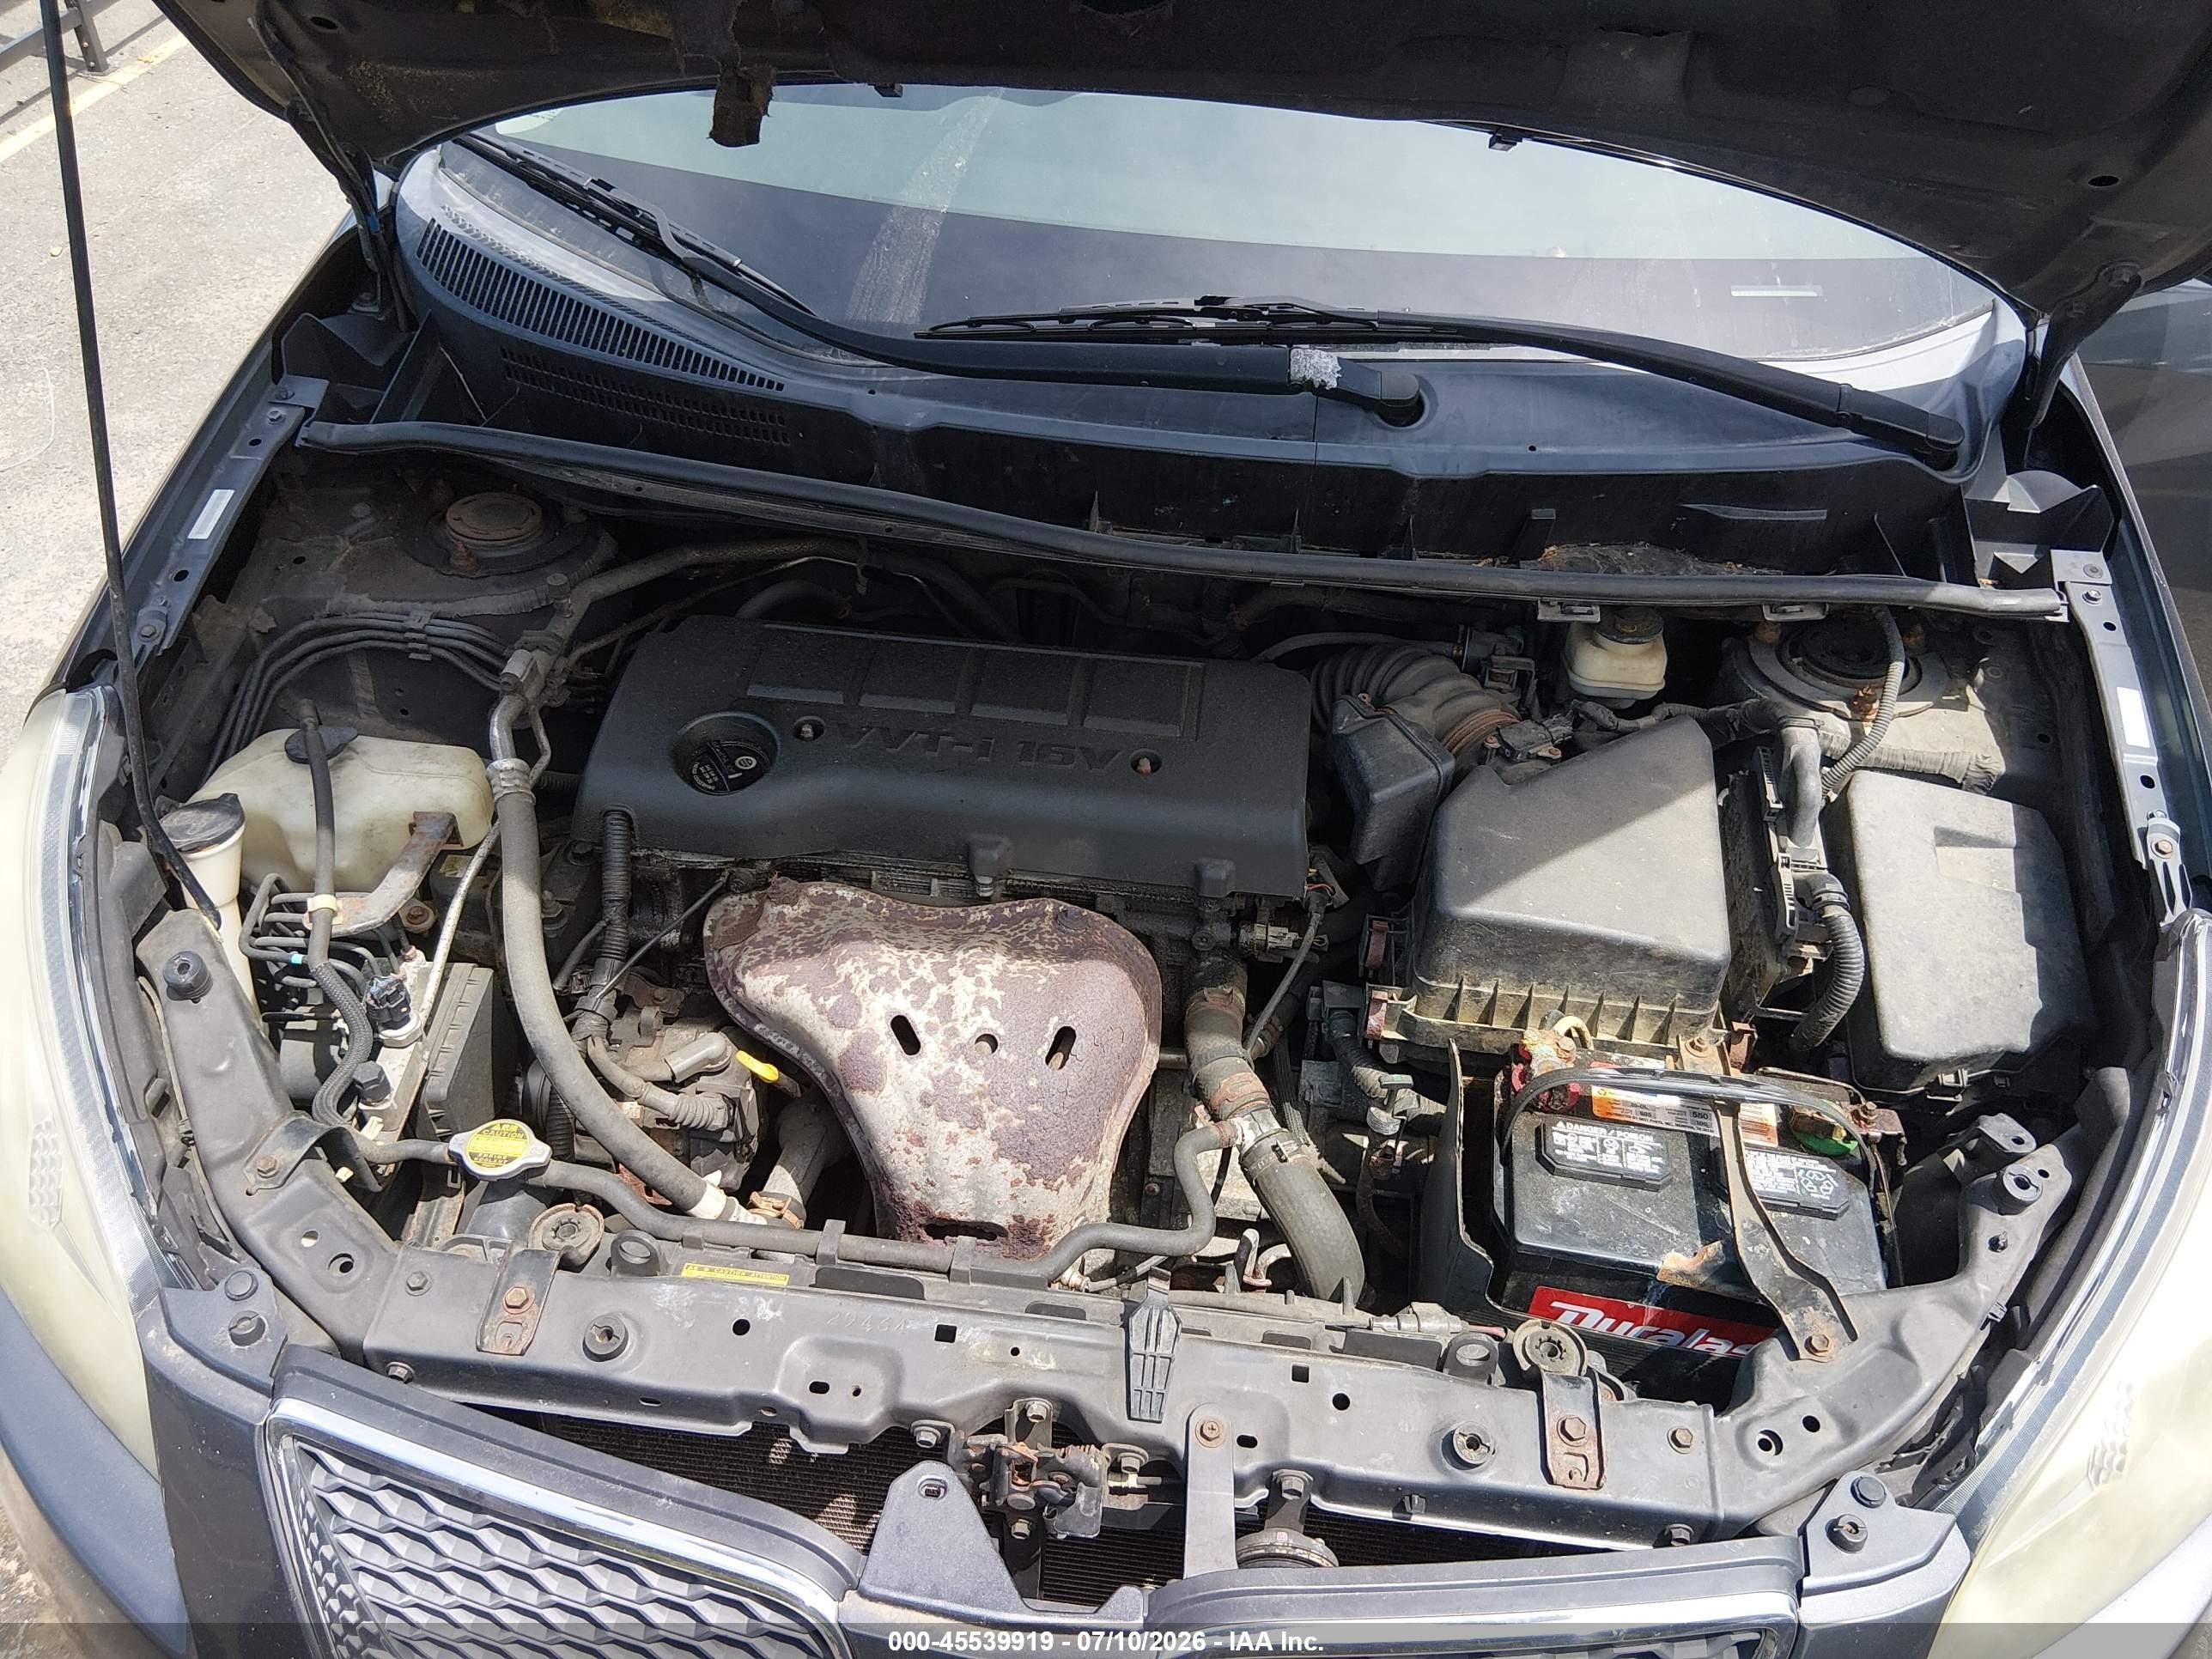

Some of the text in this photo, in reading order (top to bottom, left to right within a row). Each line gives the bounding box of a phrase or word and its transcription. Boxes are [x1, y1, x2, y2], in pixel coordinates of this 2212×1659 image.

[1692, 1111, 1709, 1120] 550
[483, 1129, 524, 1139] CAUTION
[1550, 1301, 1756, 1356] Duralas
